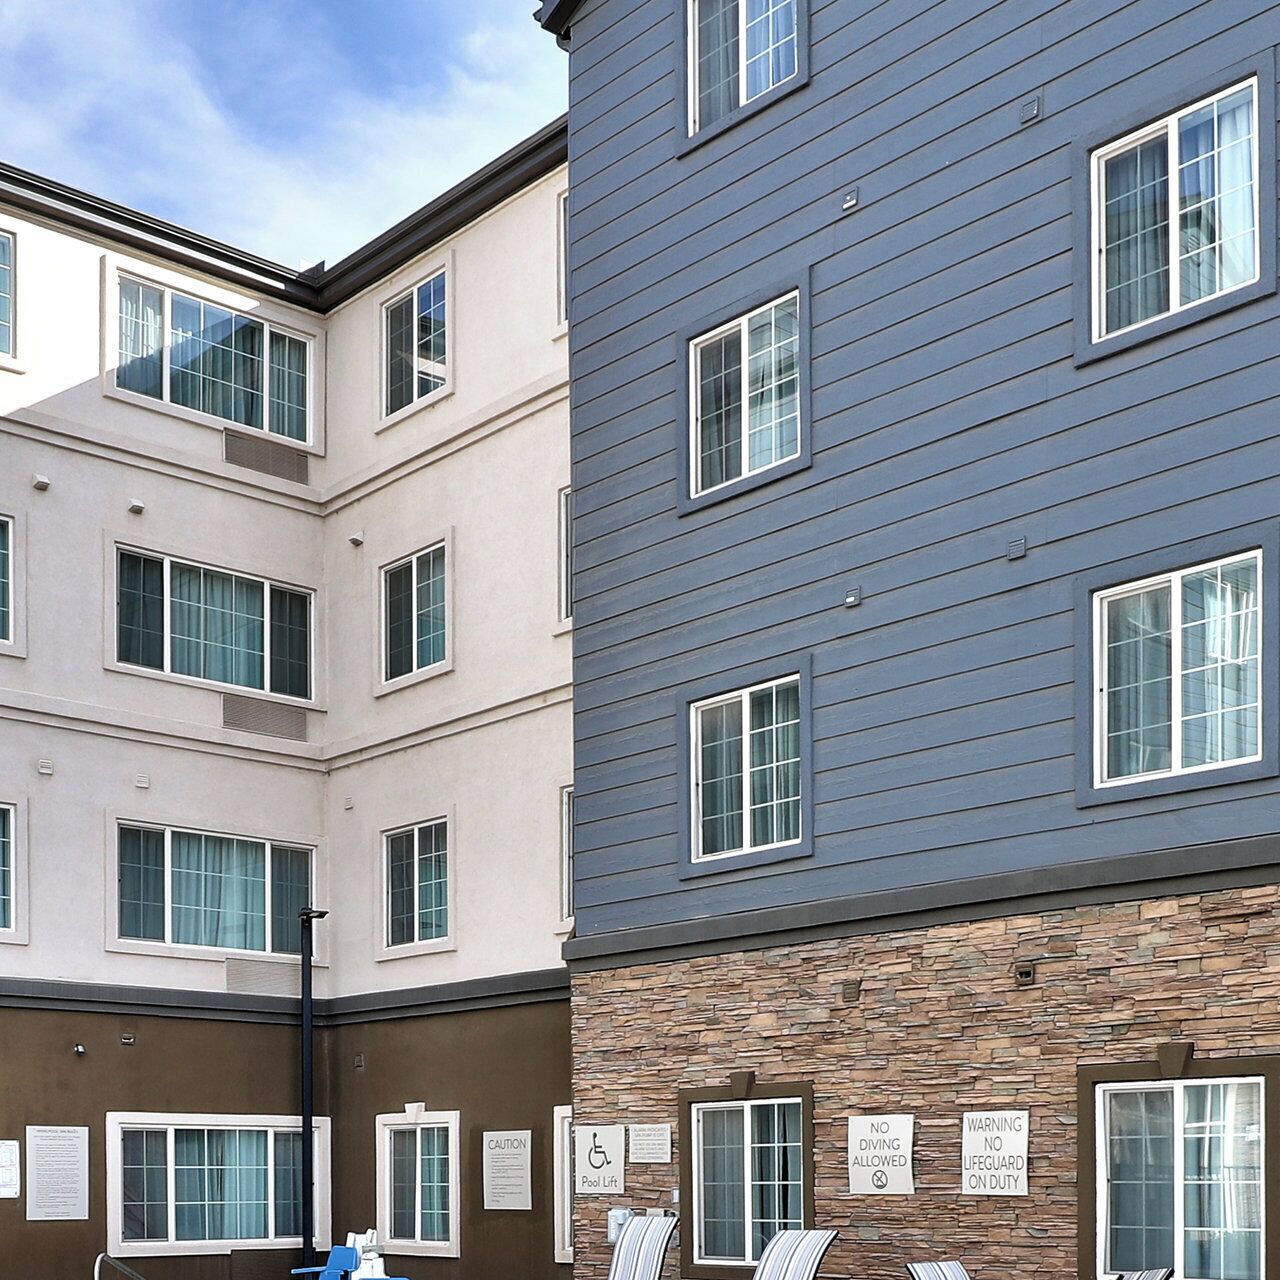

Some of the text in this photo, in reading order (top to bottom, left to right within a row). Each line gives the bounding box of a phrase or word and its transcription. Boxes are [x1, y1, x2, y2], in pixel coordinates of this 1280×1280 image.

[870, 1121, 890, 1134] NO
[968, 1116, 1022, 1132] WARNING
[488, 1138, 526, 1150] CAUTION
[859, 1138, 901, 1151] DIVING
[984, 1136, 1003, 1151] NO
[852, 1154, 907, 1167] ALLOWED
[963, 1155, 1024, 1171] LIFEGUARD
[581, 1175, 618, 1188] Pool Lift
[968, 1174, 1020, 1190] ON DUTY
